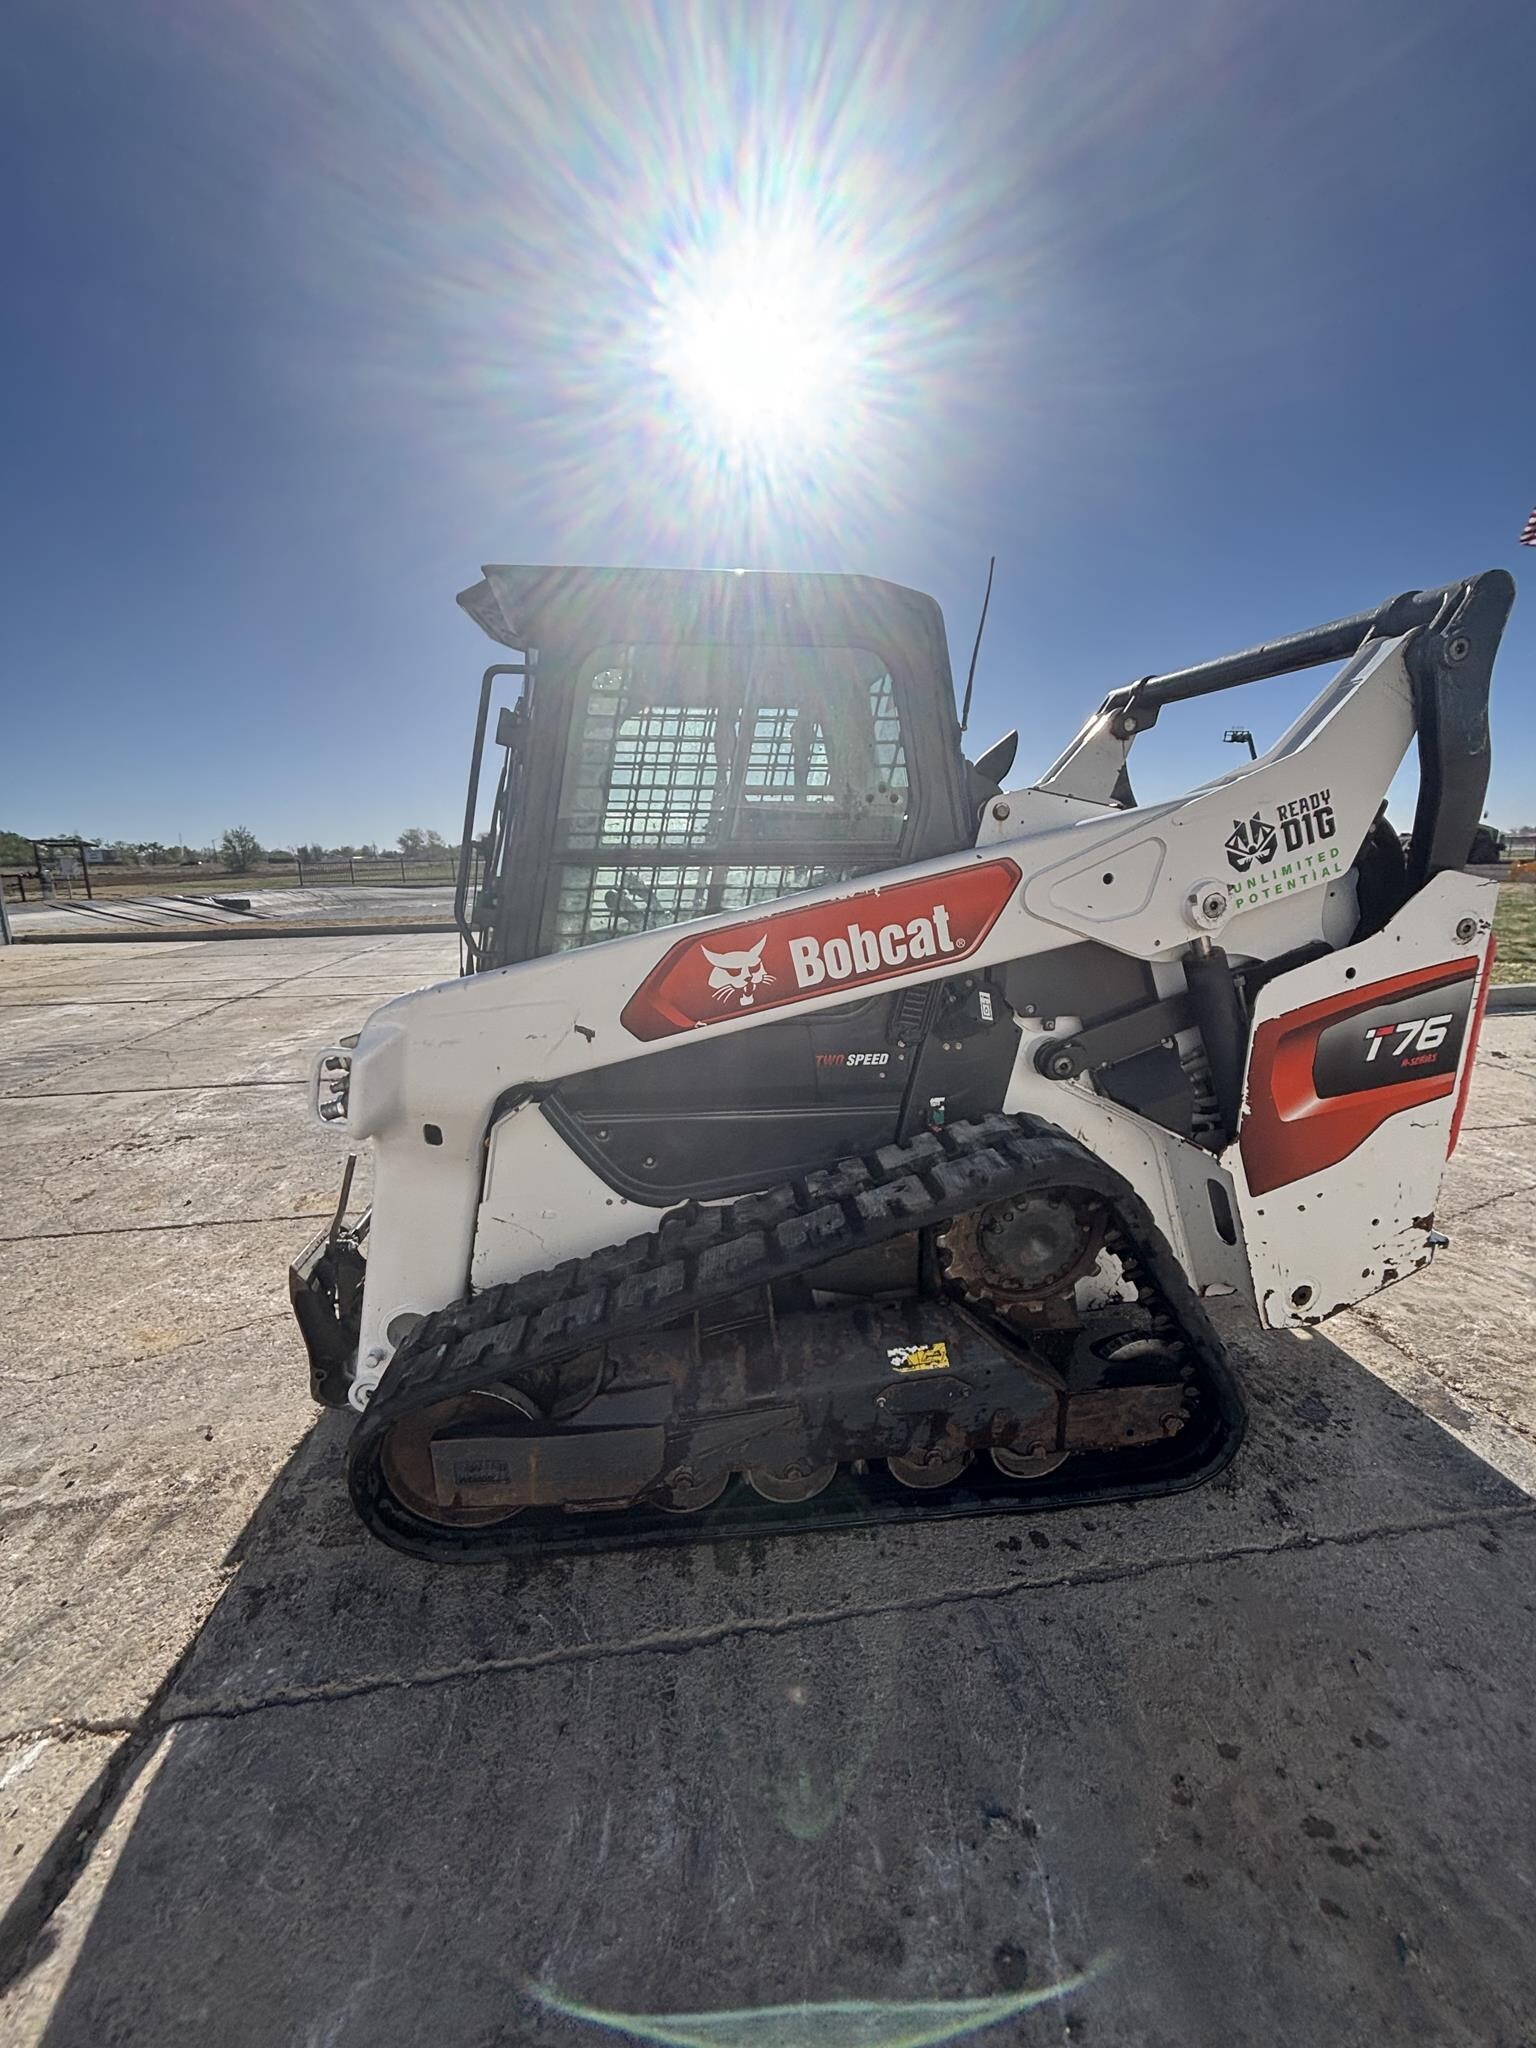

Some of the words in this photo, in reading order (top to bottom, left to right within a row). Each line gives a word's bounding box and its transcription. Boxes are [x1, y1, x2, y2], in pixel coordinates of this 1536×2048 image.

[1276, 788, 1331, 821] READY
[1280, 806, 1336, 853] DIG
[1233, 847, 1340, 894] UNLIMITED
[1235, 863, 1342, 909] POTENTIAL
[788, 904, 955, 989] Bobcat
[816, 1054, 845, 1067] TWO
[846, 1053, 889, 1067] SPEED
[1365, 1013, 1453, 1062] T76
